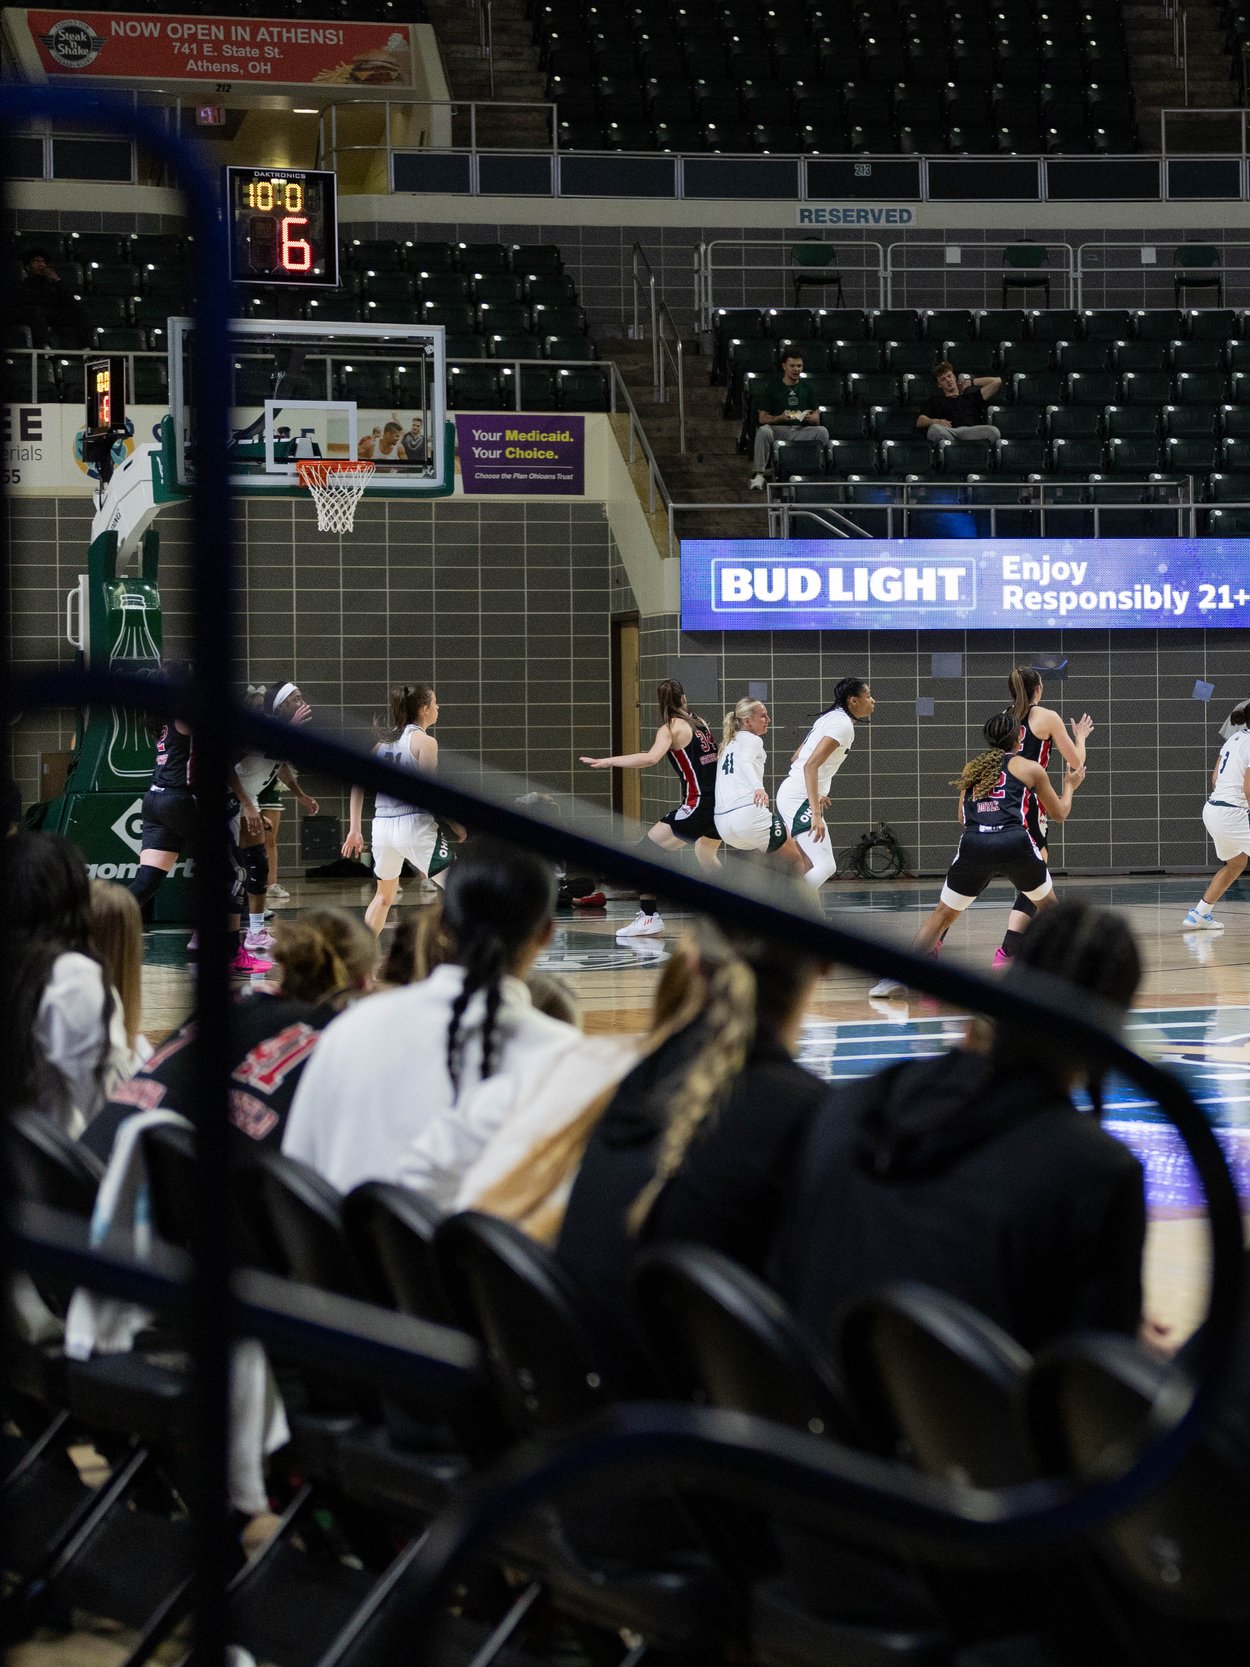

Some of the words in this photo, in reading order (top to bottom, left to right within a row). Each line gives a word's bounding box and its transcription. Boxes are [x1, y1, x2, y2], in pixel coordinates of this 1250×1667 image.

[58, 30, 88, 41] Steak
[111, 21, 161, 37] NOW
[167, 23, 224, 40] OPEN
[231, 26, 250, 41] IN
[256, 27, 344, 44] ATHENS!
[57, 44, 89, 55] Shake
[172, 42, 197, 55] 741
[204, 44, 218, 56] E.
[222, 44, 259, 58] State
[264, 46, 284, 58] St.
[186, 59, 244, 75] Athens,
[248, 61, 271, 74] OH
[216, 84, 232, 93] 212
[254, 171, 307, 179] DAKTRONICS
[854, 164, 872, 176] 213
[800, 208, 913, 224] RESERVED
[282, 217, 311, 270] 6
[472, 429, 502, 441] Your
[505, 430, 574, 442] Medicaid.
[472, 447, 502, 458] Your
[505, 447, 559, 459] Choice.
[1002, 555, 1088, 584] Enjoy
[720, 566, 821, 602] BUD
[828, 565, 968, 602] LIGHT
[1002, 584, 1190, 616] Responsibly
[1197, 585, 1250, 610] 21+
[721, 752, 735, 775] 41
[87, 858, 196, 880] gomrt
